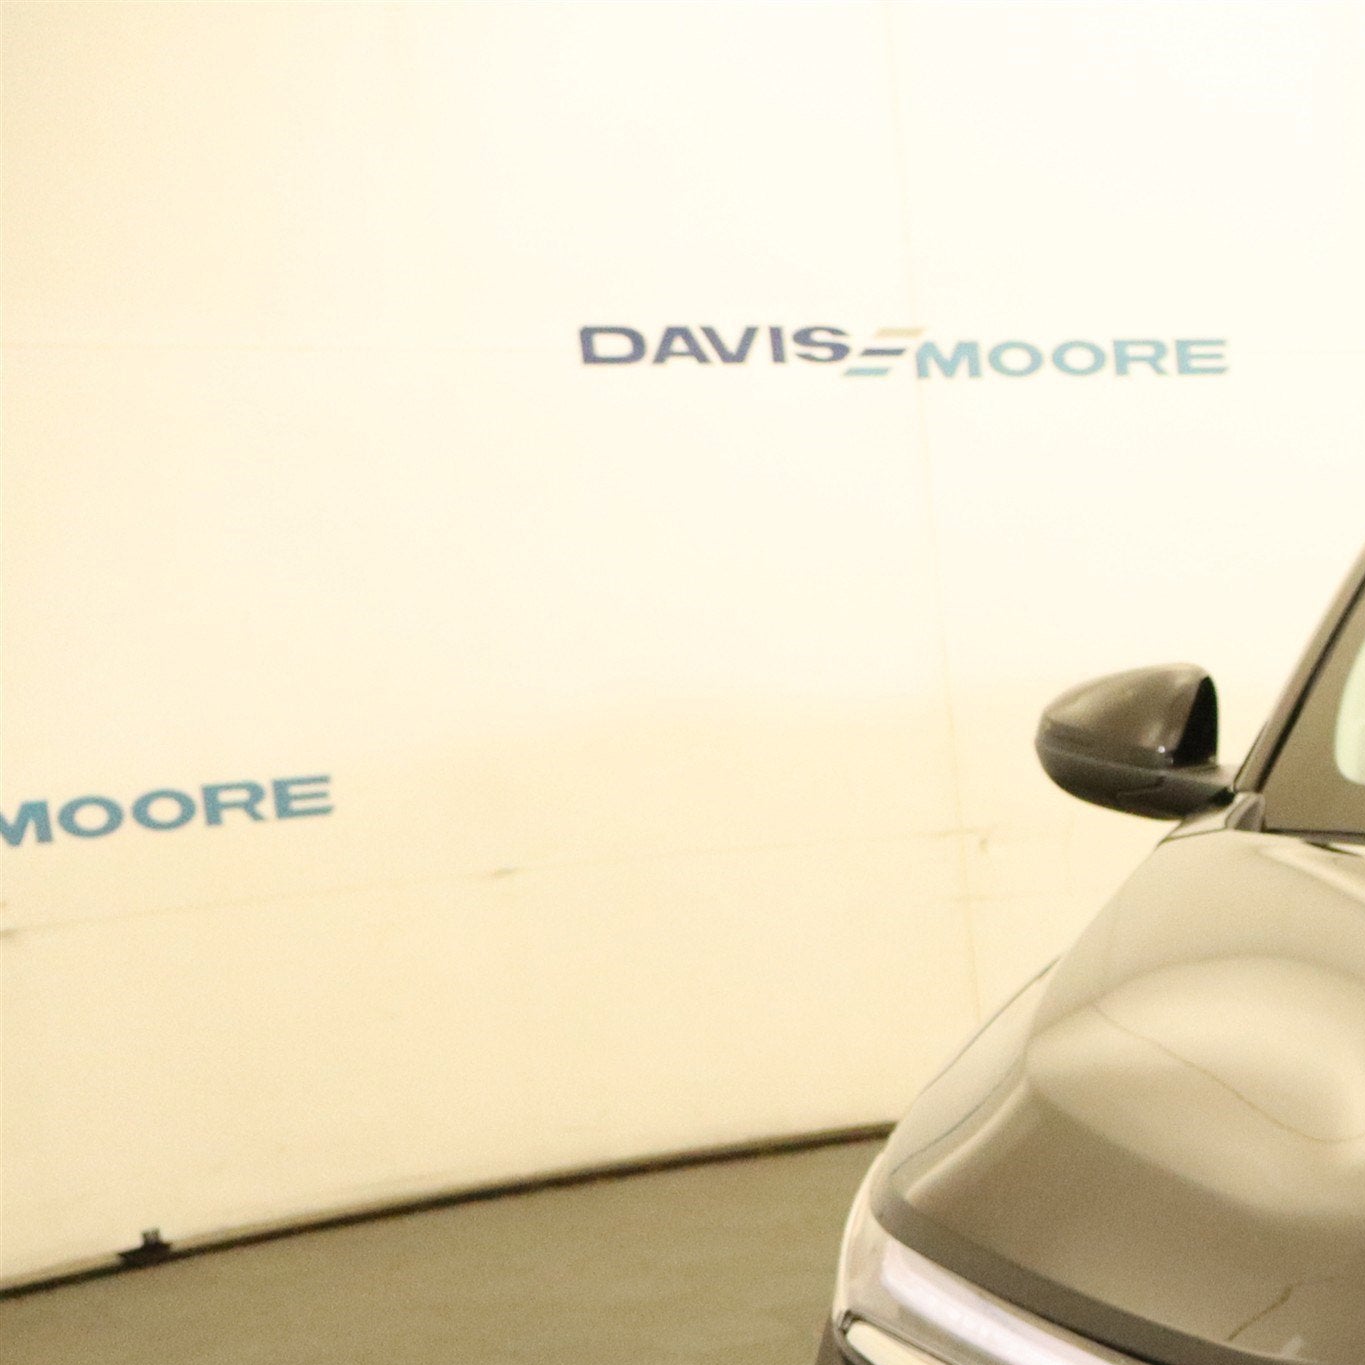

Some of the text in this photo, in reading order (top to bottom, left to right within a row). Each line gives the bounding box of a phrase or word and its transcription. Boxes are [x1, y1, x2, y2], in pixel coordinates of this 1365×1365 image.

[578, 325, 1230, 380] DAVIS MOORE
[0, 775, 334, 847] MOORE
